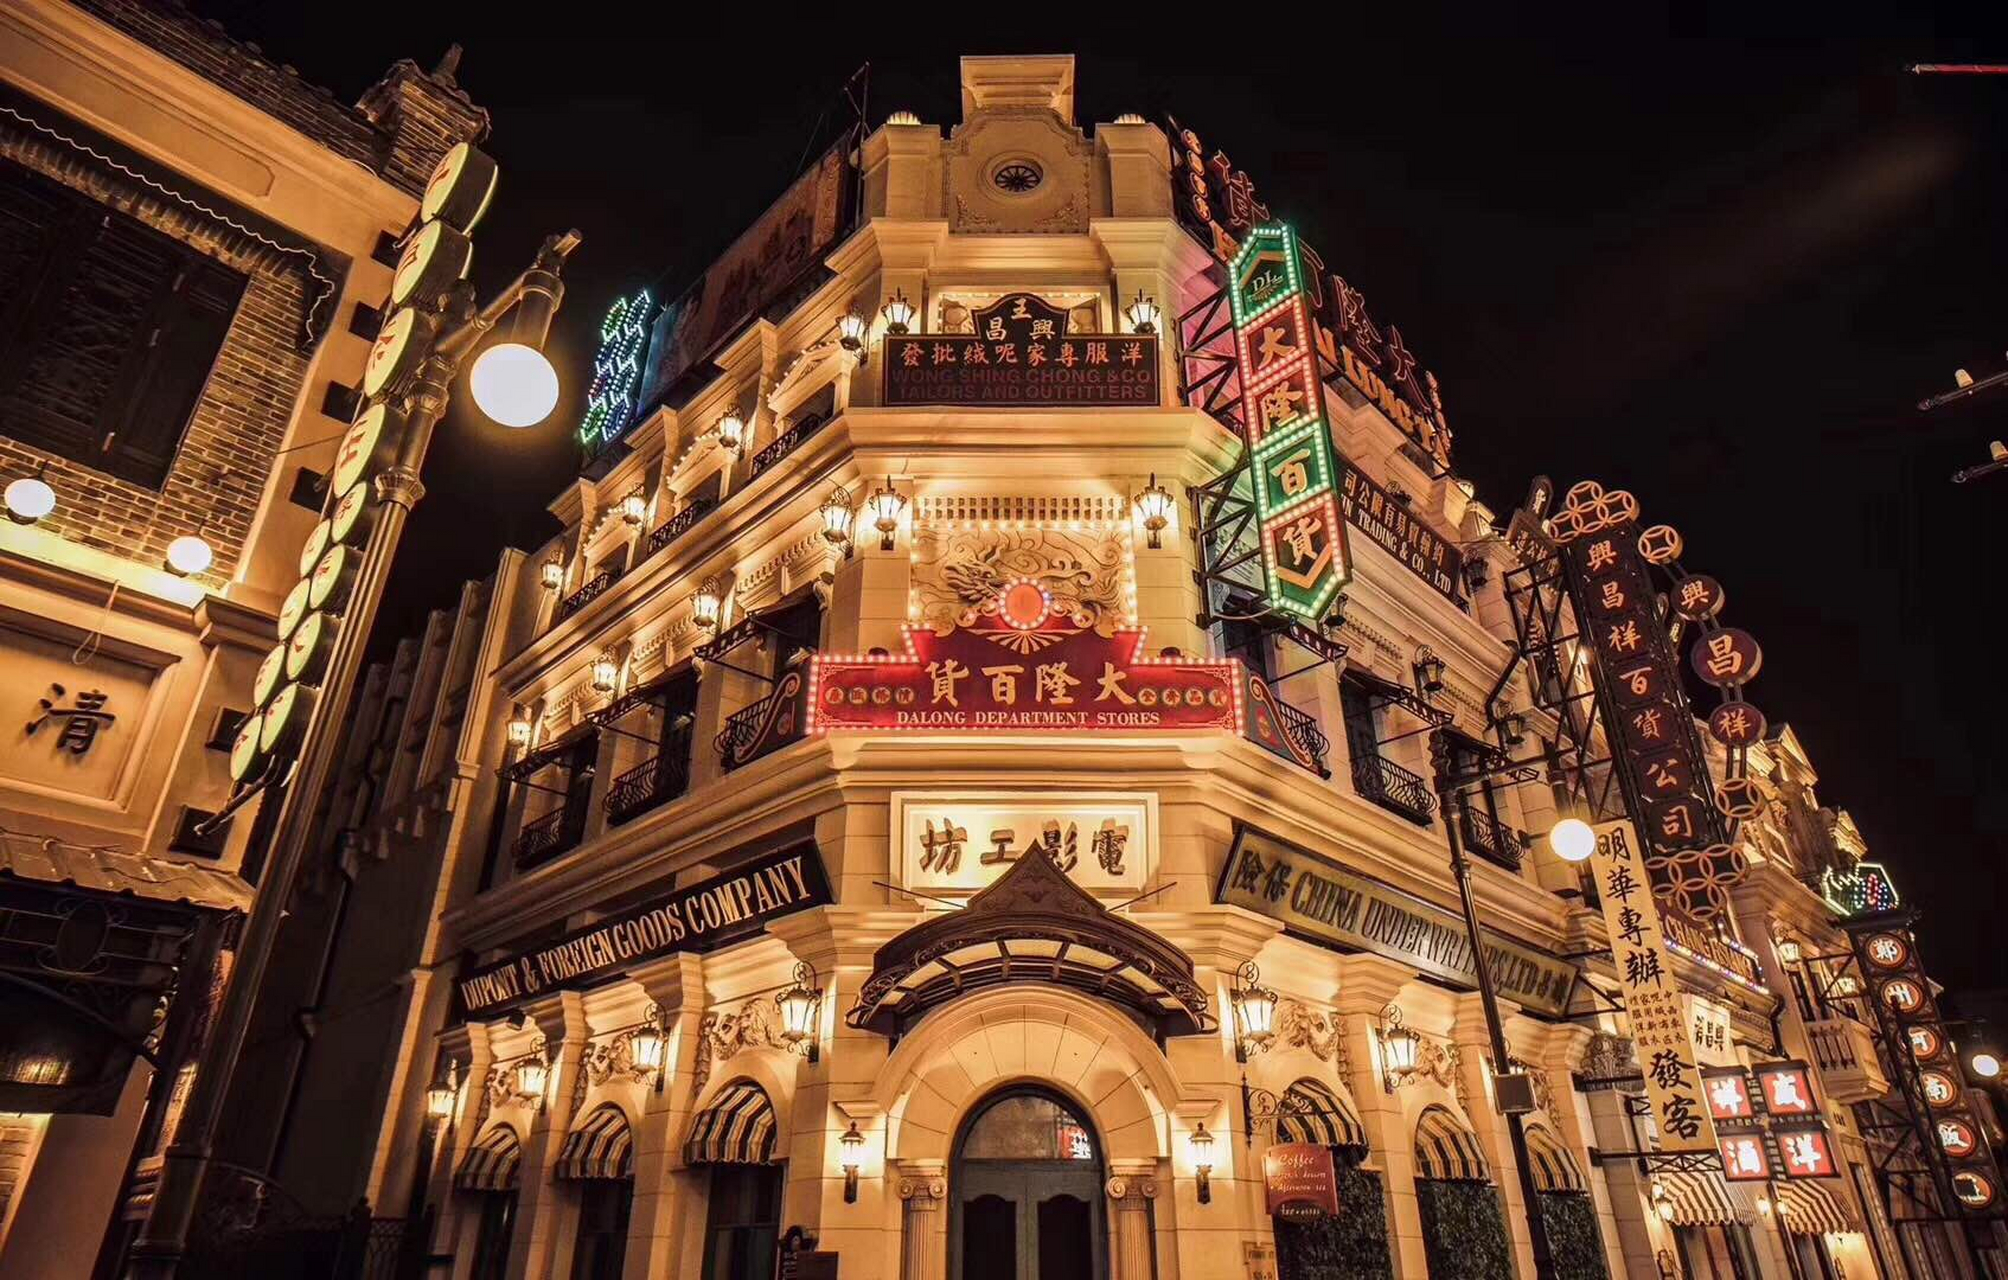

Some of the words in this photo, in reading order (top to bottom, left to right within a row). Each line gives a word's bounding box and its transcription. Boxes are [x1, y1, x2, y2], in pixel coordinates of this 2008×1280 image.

[892, 369, 954, 384] WONG
[959, 369, 1020, 384] SHING
[1025, 369, 1101, 384] CHONG
[899, 385, 977, 399] TAILORS
[982, 385, 1020, 399] AND
[1025, 385, 1148, 399] OUTFITTERS
[1257, 327, 1323, 567] 大隆百貨
[1358, 509, 1399, 553] TRADING
[1399, 541, 1409, 561] &
[1434, 569, 1452, 594] LTD
[1586, 539, 1693, 839] 興昌祥百貨公司
[1680, 579, 1752, 739] 興昌祥
[24, 681, 117, 757] 清
[897, 711, 966, 725] DALONG
[975, 711, 1088, 725] DEPARTMENT
[1097, 711, 1160, 725] STORES
[461, 964, 521, 1010] DUPONT
[521, 957, 540, 993] &
[538, 928, 614, 985] FOREIGN
[613, 903, 685, 960] GOODS
[685, 856, 811, 934] COMPANY
[1291, 871, 1364, 933] CHINA
[1278, 1153, 1315, 1168] Coffee
